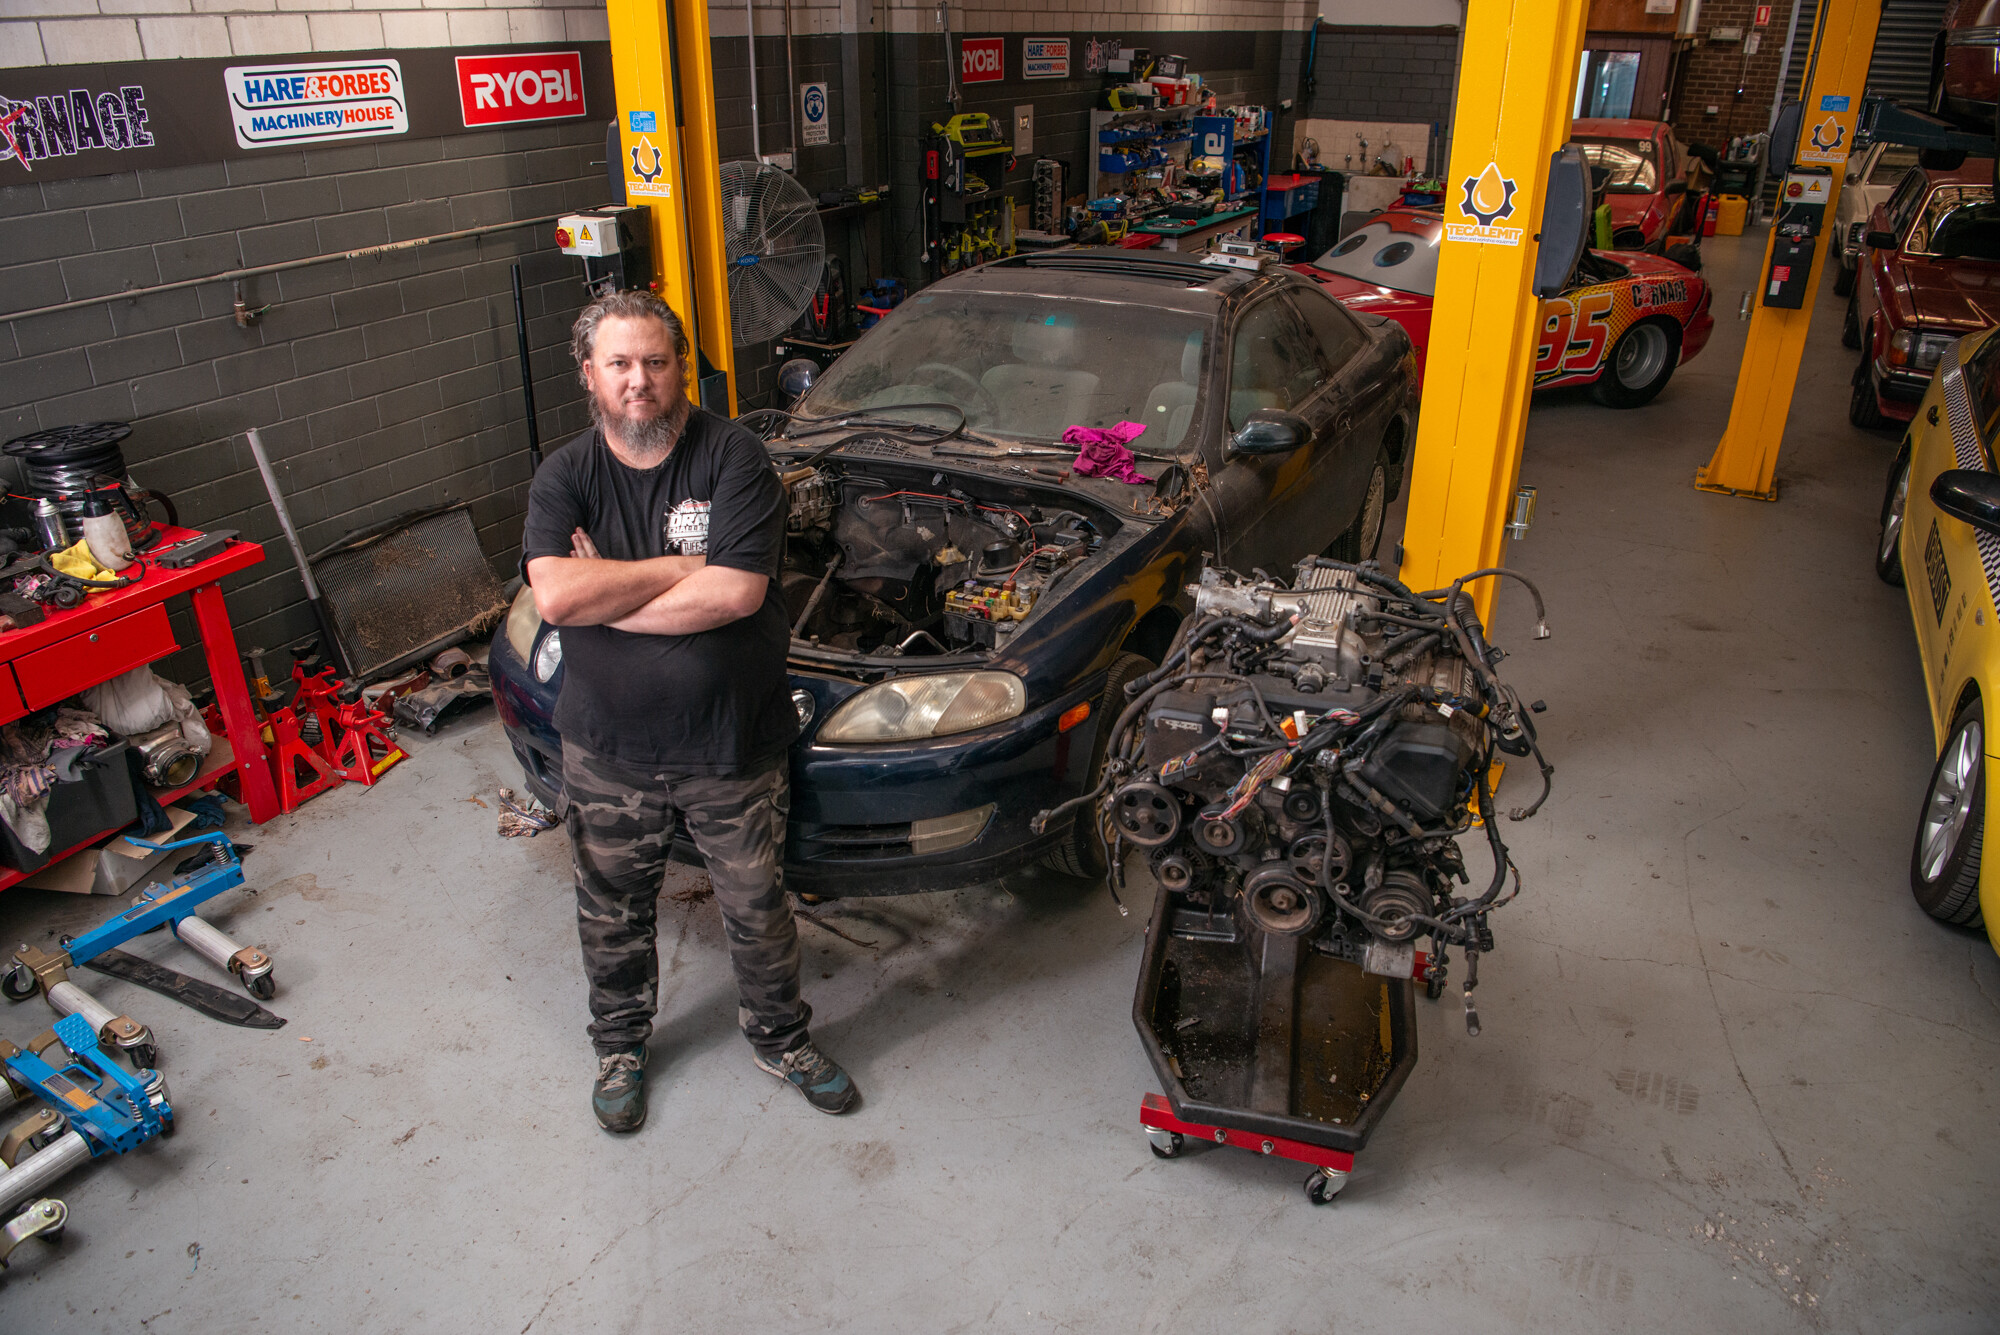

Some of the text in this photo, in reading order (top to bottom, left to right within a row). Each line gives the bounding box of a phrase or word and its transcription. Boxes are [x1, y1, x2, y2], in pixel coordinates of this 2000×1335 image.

[1639, 141, 1652, 153] 99
[1802, 151, 1846, 160] TECALEMIT
[628, 182, 670, 193] TECALEMIT
[1447, 224, 1522, 240] TECALEMIT
[1536, 292, 1613, 374] 95
